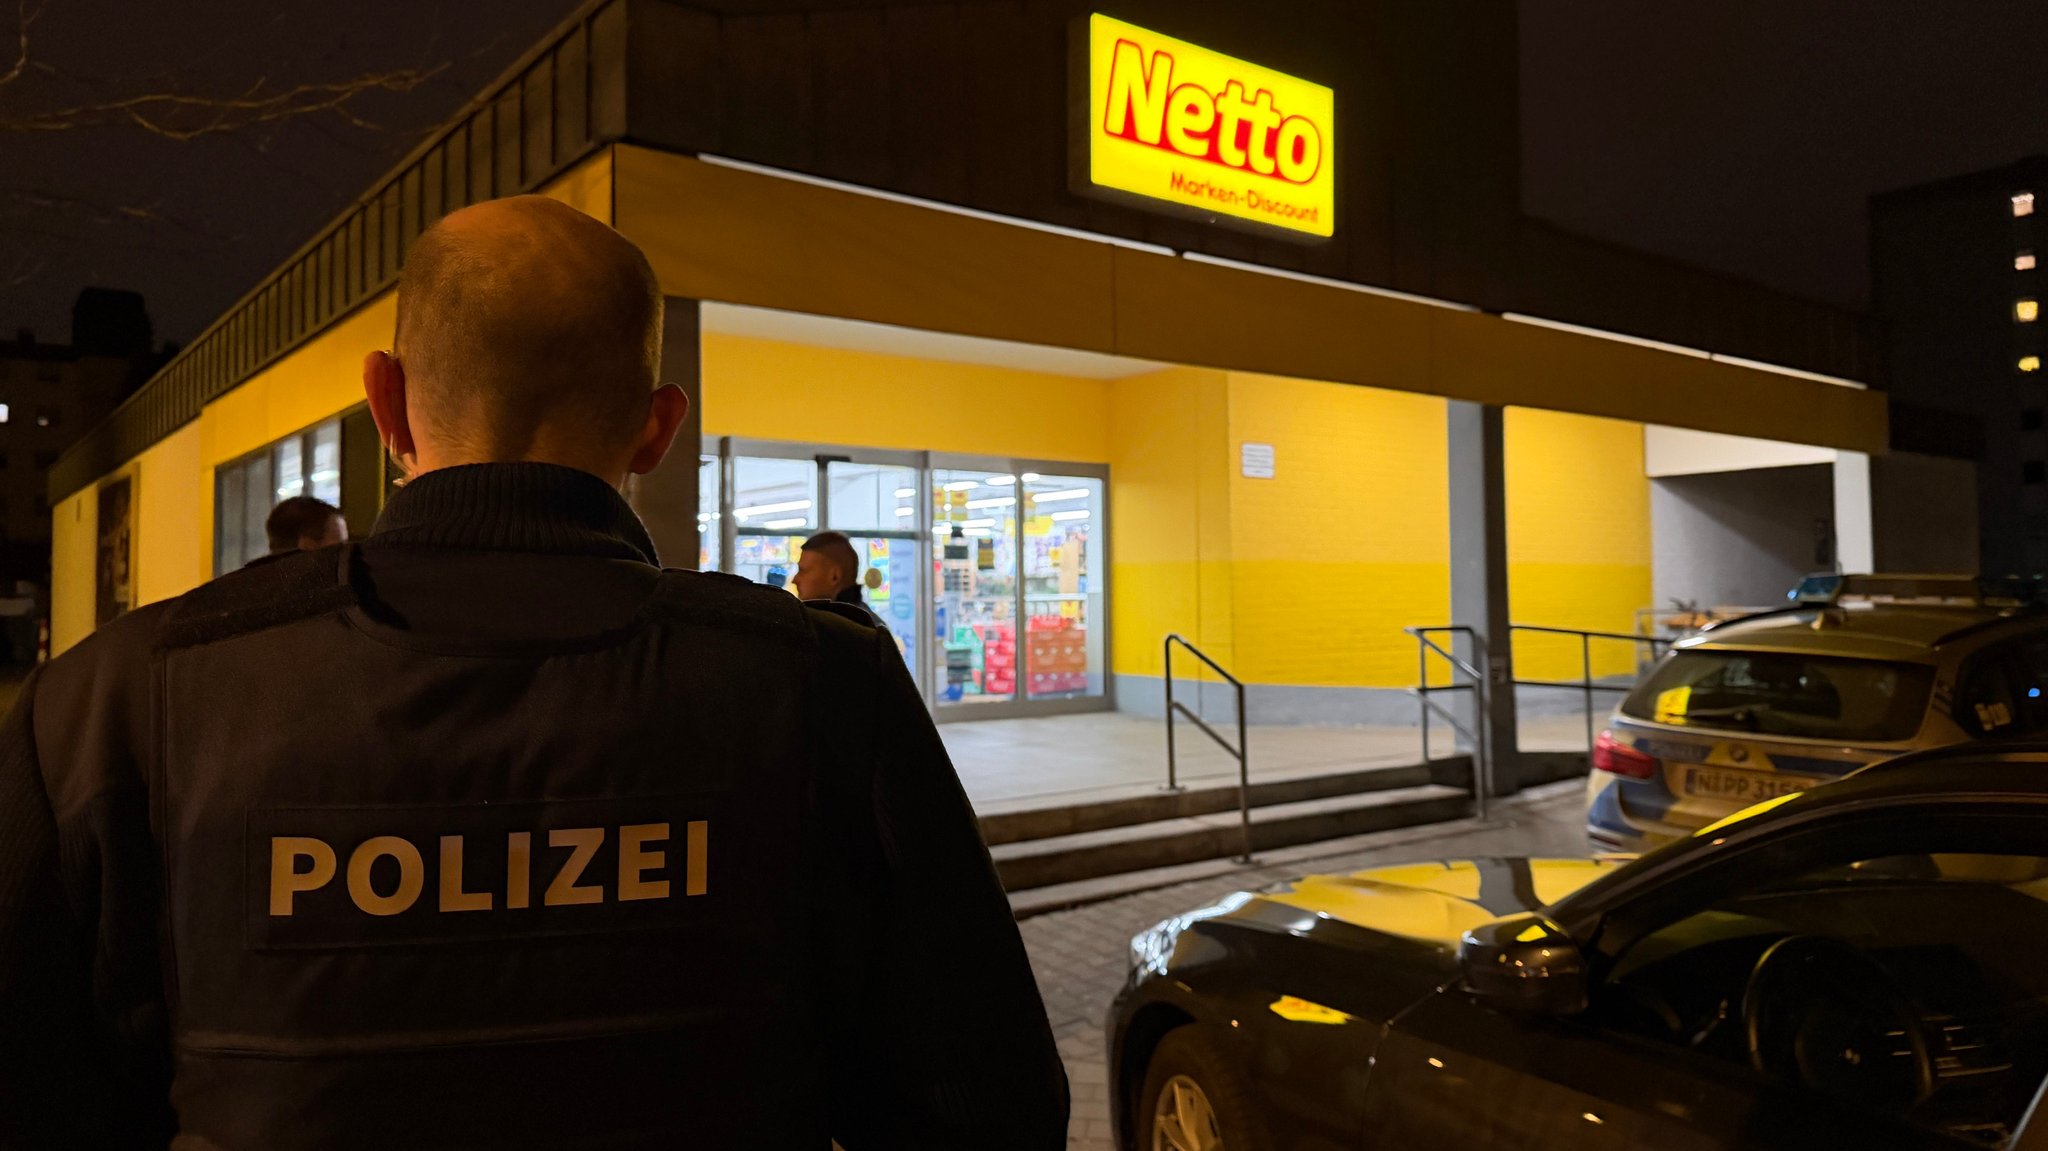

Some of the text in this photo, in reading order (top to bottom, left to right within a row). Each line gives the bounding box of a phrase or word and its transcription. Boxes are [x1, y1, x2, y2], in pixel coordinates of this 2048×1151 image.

[1104, 38, 1322, 186] Netto
[1169, 171, 1319, 224] Marken-Discount
[1698, 773, 1711, 791] N
[1724, 775, 1749, 795] PP
[269, 820, 708, 916] POLIZEI
